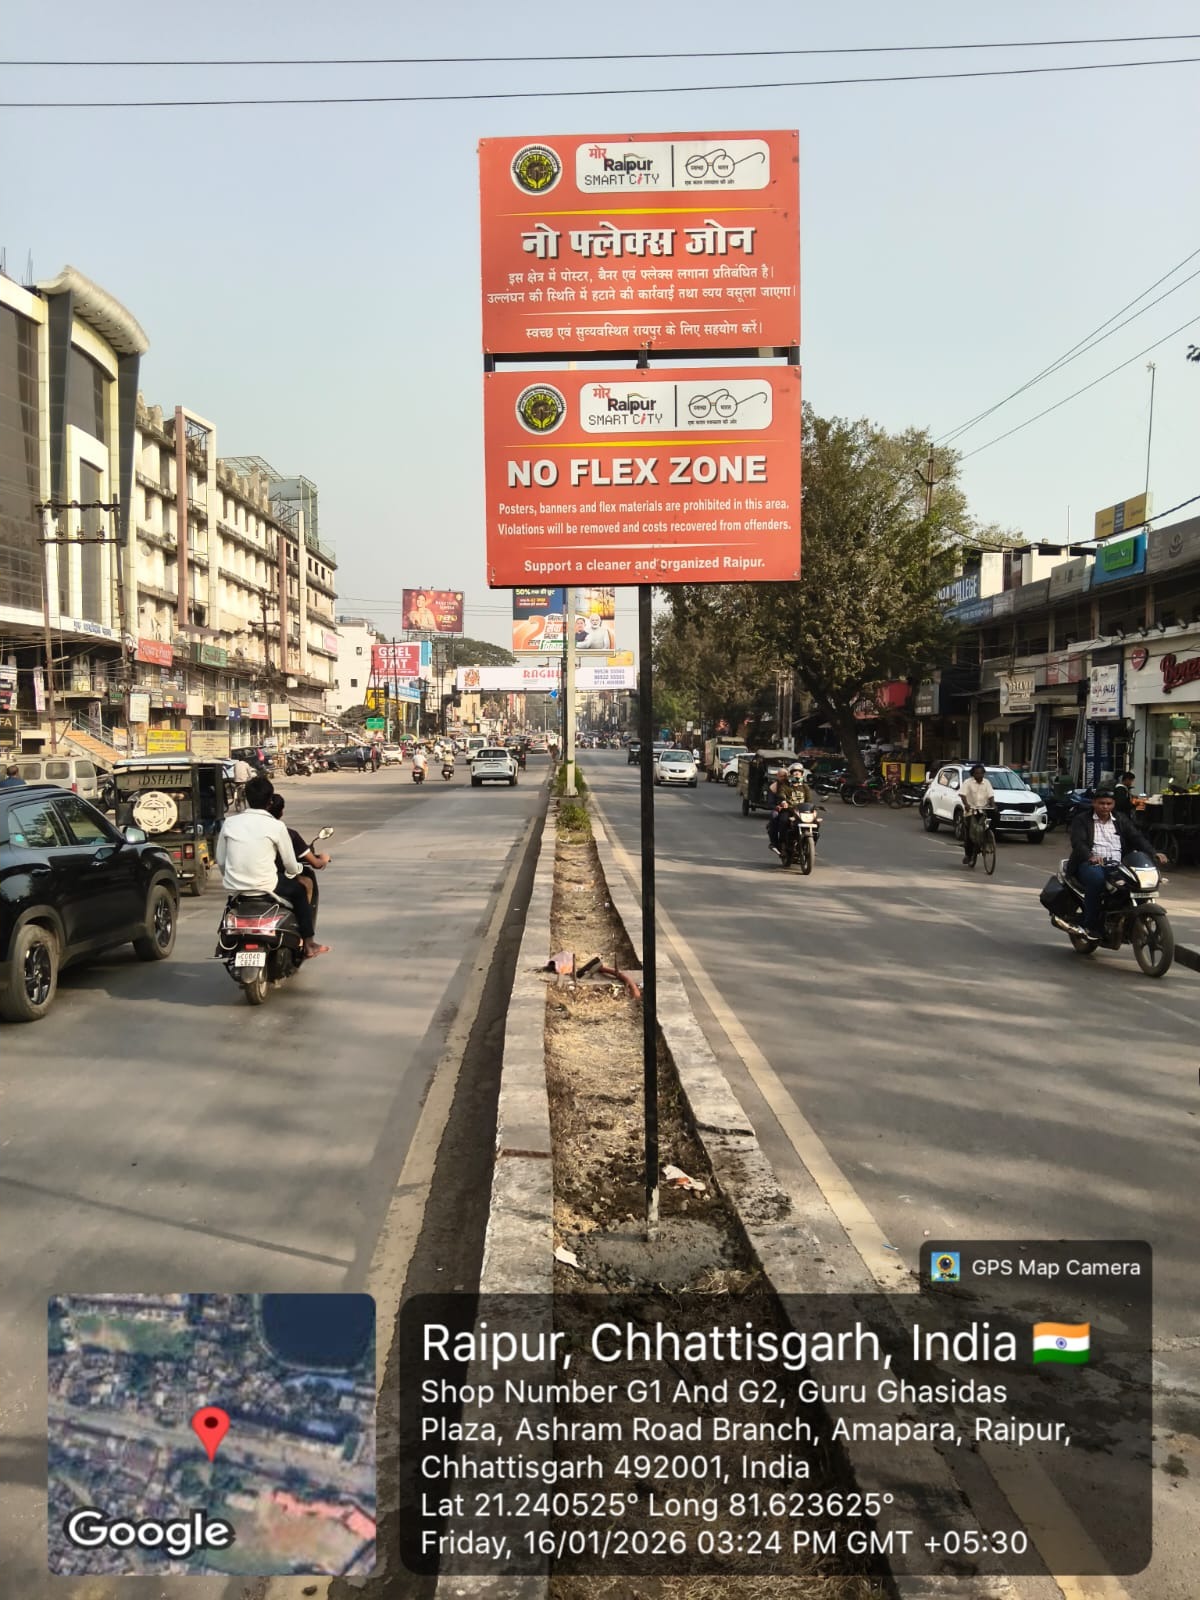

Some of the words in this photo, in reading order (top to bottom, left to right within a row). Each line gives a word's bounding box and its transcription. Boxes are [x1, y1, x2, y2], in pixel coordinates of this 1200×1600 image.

[588, 144, 606, 158] मोर
[604, 156, 654, 174] Raipur
[584, 174, 625, 186] SMART
[520, 222, 560, 258] नो
[568, 220, 675, 256] फ्लेक्स
[682, 218, 755, 254] जोन
[508, 273, 523, 284] इस
[527, 269, 544, 283] क्षेत्र
[560, 268, 592, 283] पोस्टर,
[597, 266, 618, 280] बैनर
[621, 269, 636, 282] एवं
[639, 265, 673, 280] फ्लेक्स
[676, 268, 708, 279] लगाना
[712, 263, 758, 278] प्रतिबंधित
[487, 292, 524, 303] उल्लंघन
[528, 288, 543, 301] की
[546, 286, 575, 301] स्थिति
[579, 286, 587, 300] में
[591, 286, 616, 302] हटाने
[619, 285, 634, 300] की
[637, 284, 674, 301] कार्रवाई
[677, 288, 698, 298] तथा
[701, 287, 722, 298] व्यय
[726, 287, 756, 302] वसूला
[525, 327, 553, 338] स्वच्छ
[556, 327, 572, 340] एवं
[575, 321, 629, 341] सुव्यवस्थित
[632, 325, 661, 340] रायपुर
[665, 321, 676, 335] के
[679, 320, 700, 336] लिए
[703, 319, 738, 335] सहयोग
[592, 384, 611, 400] मोर
[607, 396, 657, 414] Raipur
[588, 414, 628, 426] SMART
[507, 459, 557, 486] NO
[570, 457, 658, 485] FLEX
[668, 454, 766, 483] ZONE
[499, 503, 536, 515] Posters,
[539, 502, 577, 514] banners
[579, 501, 596, 513] and
[598, 500, 616, 512] flex
[618, 500, 662, 512] materials
[665, 502, 680, 511] are
[683, 498, 731, 513] prohibited
[733, 498, 742, 510] in
[744, 497, 763, 510] this
[764, 500, 789, 510] area.
[498, 523, 544, 535] Violations
[546, 522, 563, 534] will
[566, 522, 577, 534] be
[580, 521, 620, 534] removed
[622, 521, 639, 533] and
[642, 521, 667, 532] costs
[670, 519, 717, 532] recovered
[719, 519, 741, 531] from
[743, 518, 791, 530] offenders.
[524, 559, 571, 574] Support
[575, 561, 582, 571] a
[586, 559, 631, 570] cleaner
[634, 558, 658, 570] and
[660, 556, 719, 572] organized
[722, 556, 765, 570] Raipur.
[378, 646, 411, 657] GOEL
